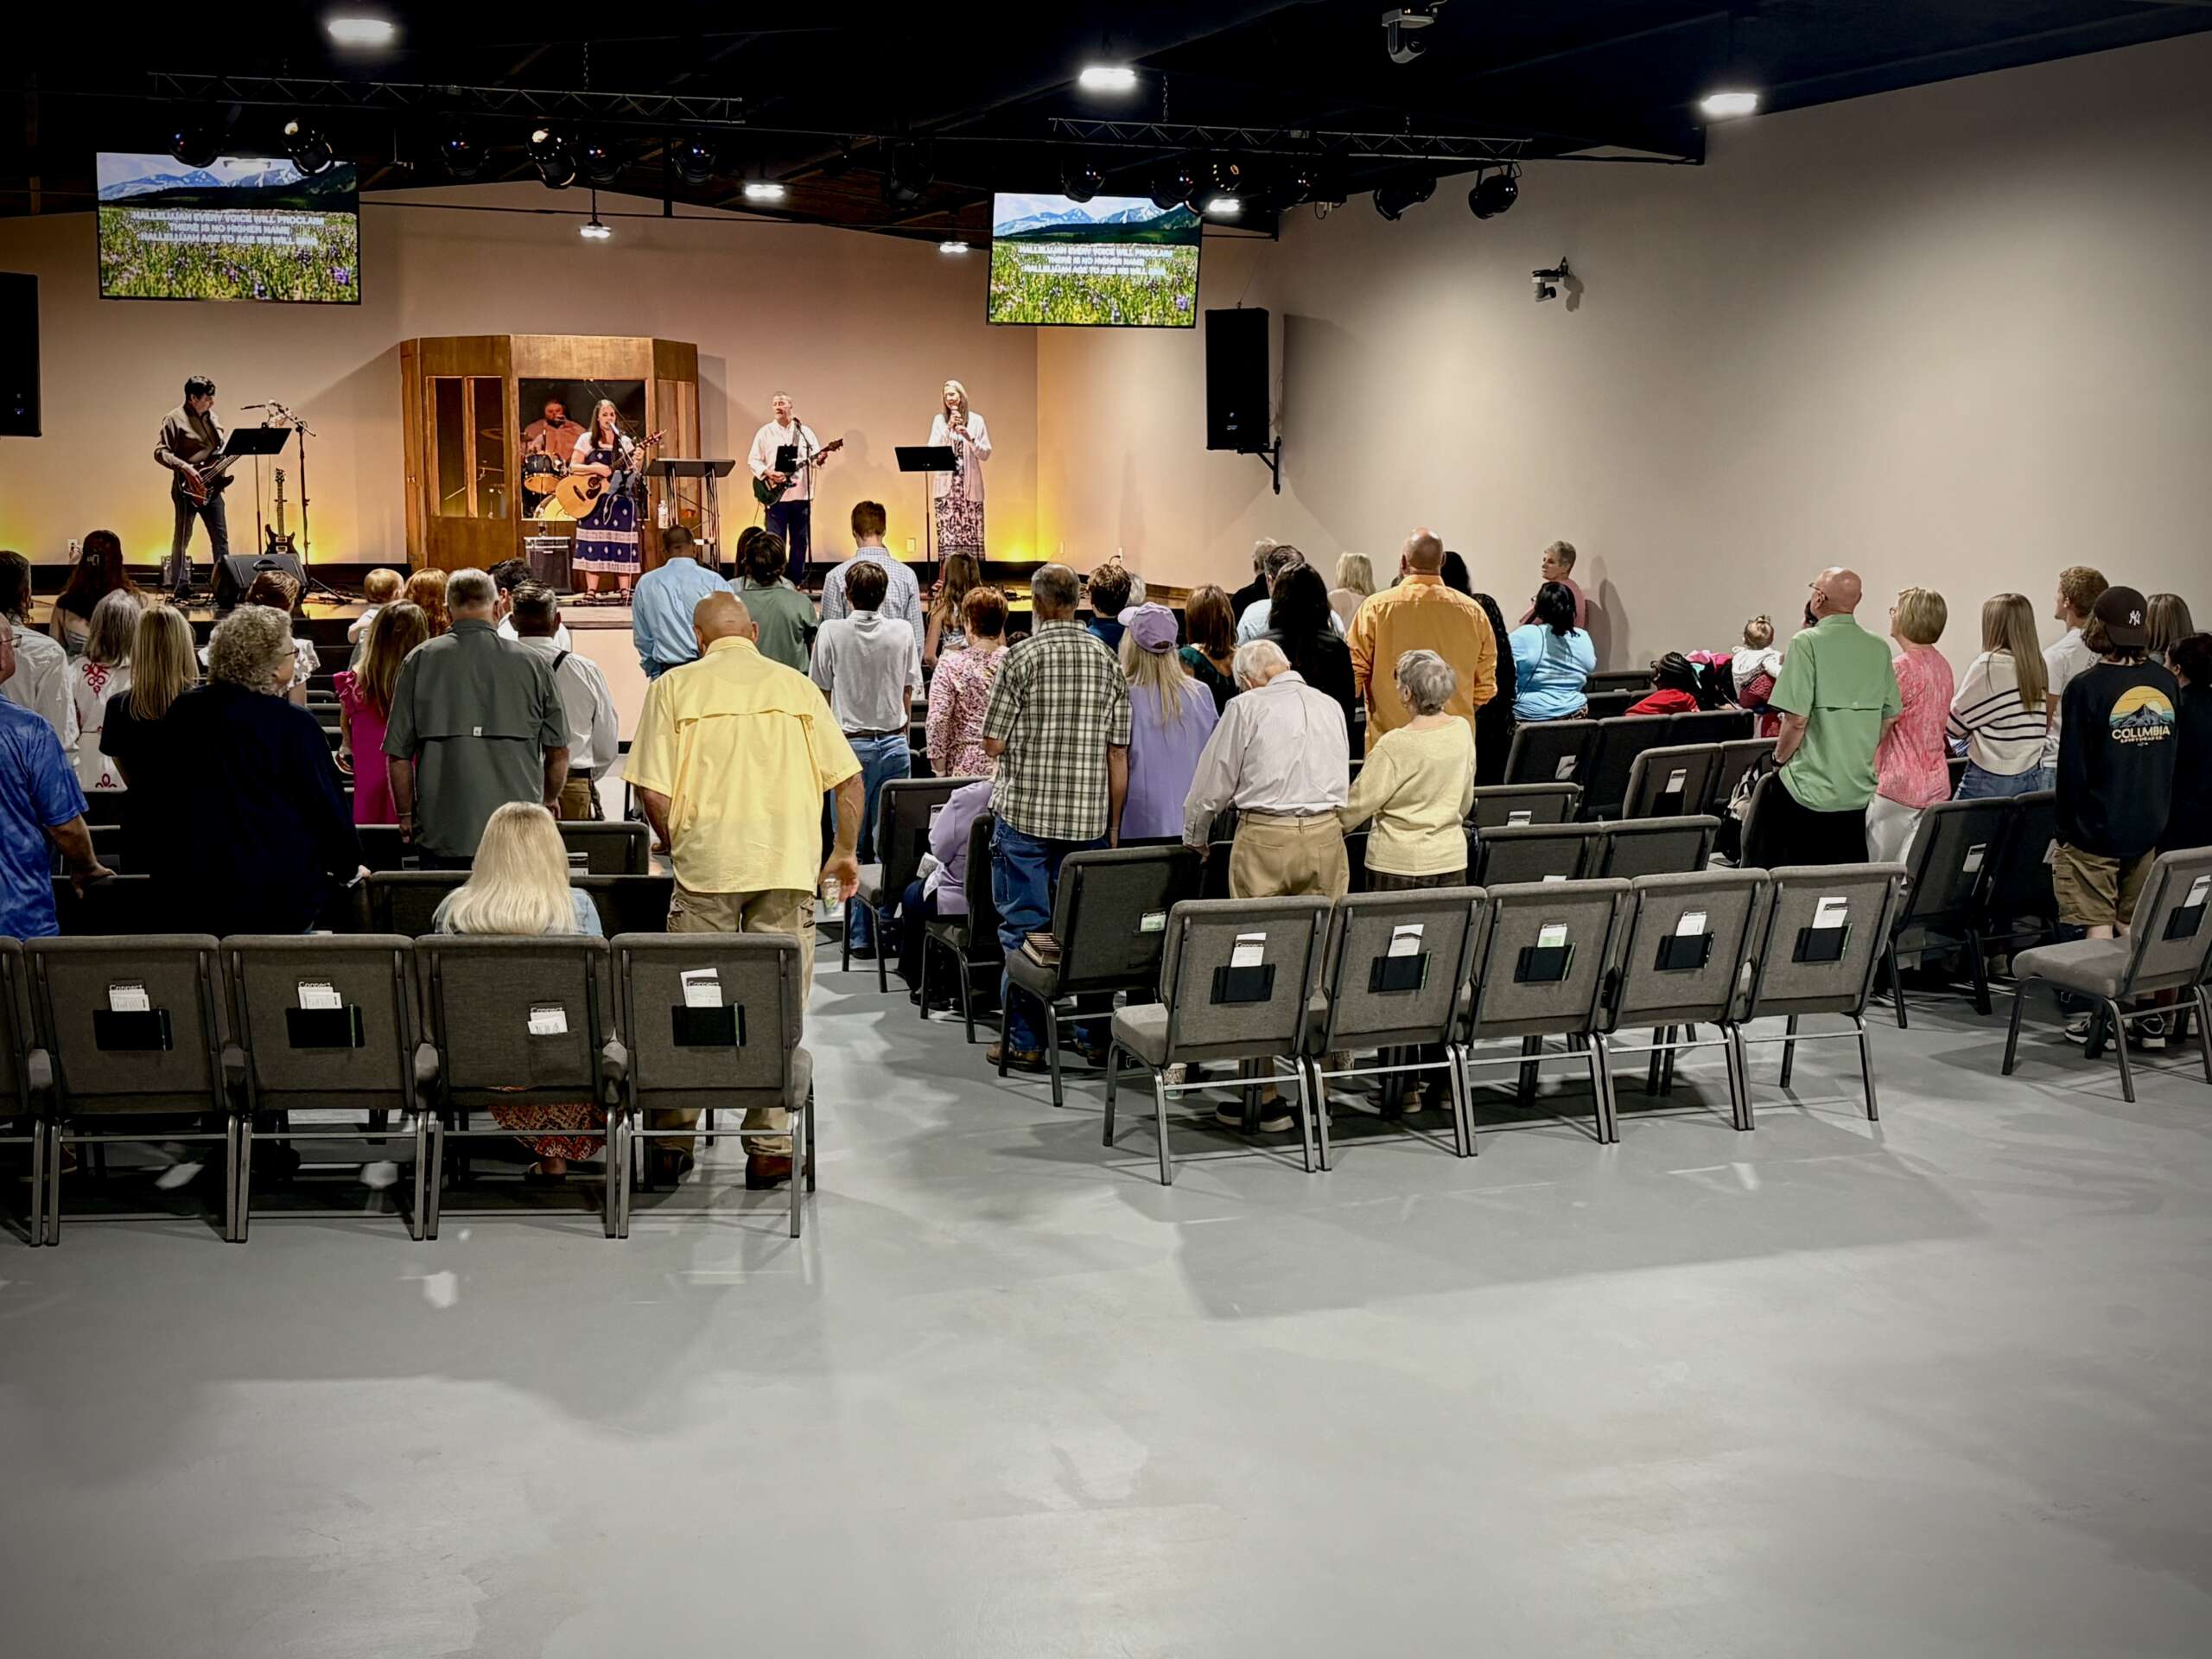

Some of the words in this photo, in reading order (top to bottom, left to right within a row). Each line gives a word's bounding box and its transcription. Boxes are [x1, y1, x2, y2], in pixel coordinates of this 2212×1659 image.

[132, 211, 192, 221] HALLELUJAH
[194, 213, 222, 222] EVERY
[225, 214, 253, 223] VOICE
[254, 215, 276, 224] WILL
[168, 222, 200, 232] THERE
[212, 224, 226, 232] NO
[226, 225, 262, 234] HIGHER
[140, 232, 200, 242] HALLELUJAH
[200, 233, 220, 243] AGE
[221, 234, 235, 244] TO
[2128, 610, 2141, 626] NY
[2111, 725, 2171, 740] COLUMBIA
